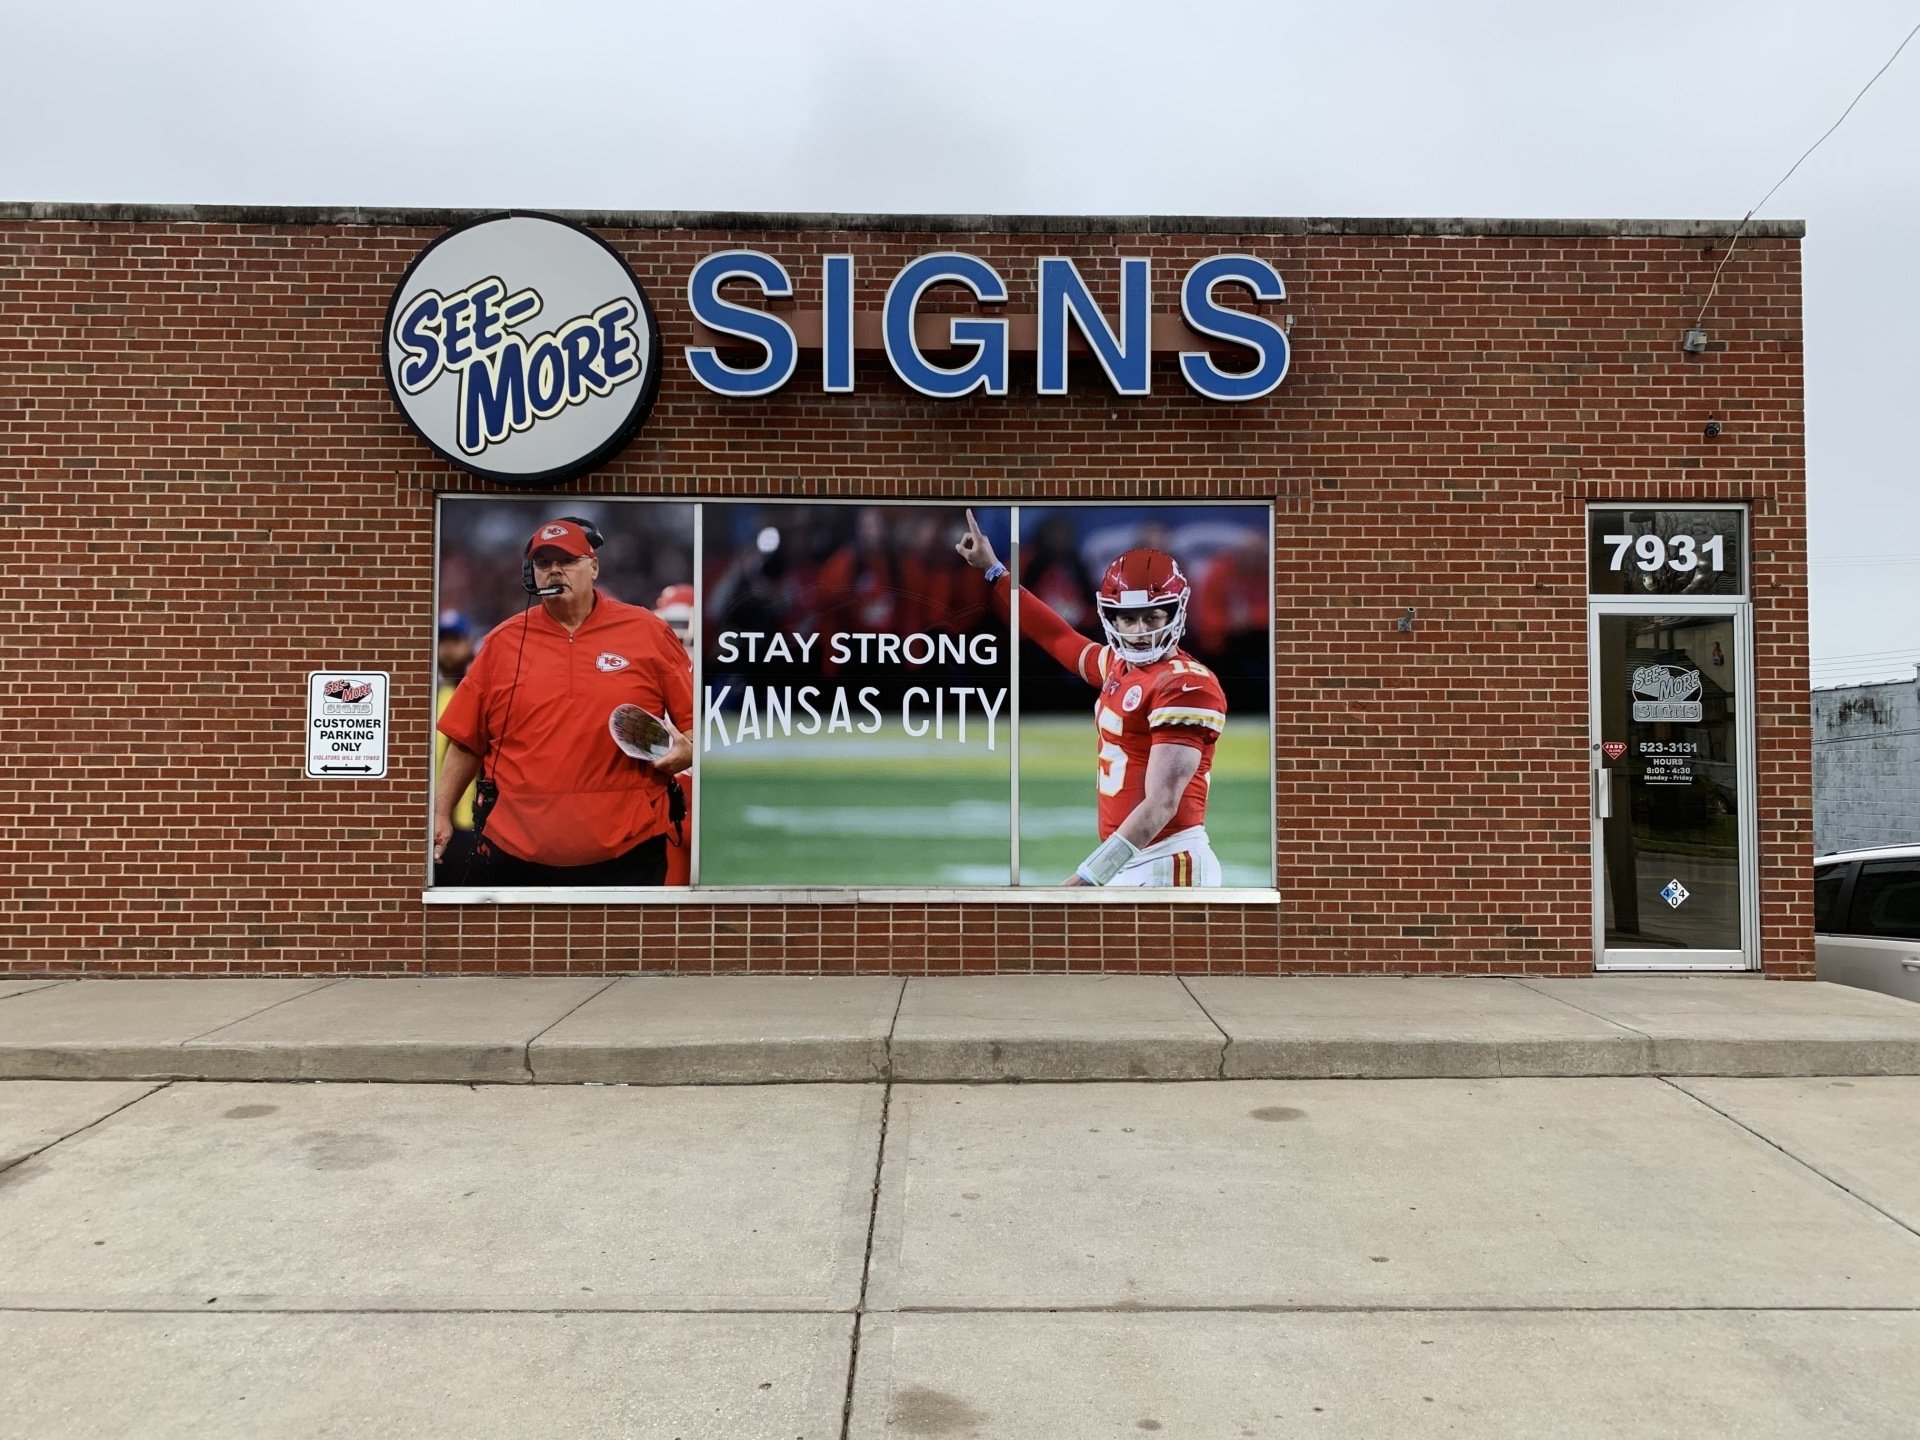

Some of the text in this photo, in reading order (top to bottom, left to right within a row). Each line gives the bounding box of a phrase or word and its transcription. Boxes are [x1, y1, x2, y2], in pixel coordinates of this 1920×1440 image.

[685, 250, 1291, 400] SIGNS
[397, 279, 540, 392] SEE-
[460, 300, 639, 453] MORE
[1603, 534, 1724, 572] 7931
[717, 631, 998, 665] STAY STRONG
[1633, 664, 1669, 691] SEE-
[342, 682, 372, 702] MORE
[1658, 669, 1700, 702] MORE
[327, 704, 371, 714] SIGNS
[1638, 704, 1699, 719] SIGNS
[313, 719, 382, 728] CUSTOMER
[704, 685, 1007, 752] KANSAS CITY
[320, 731, 374, 740] PARKING
[331, 742, 362, 752] ONLY
[1639, 742, 1697, 753] 523-3131
[1653, 758, 1684, 766] HOURS
[1644, 774, 1669, 782] Monday
[1673, 774, 1693, 782] Friday
[1671, 881, 1678, 891] 3
[1663, 888, 1686, 898] 4 4
[1671, 896, 1678, 906] 0
